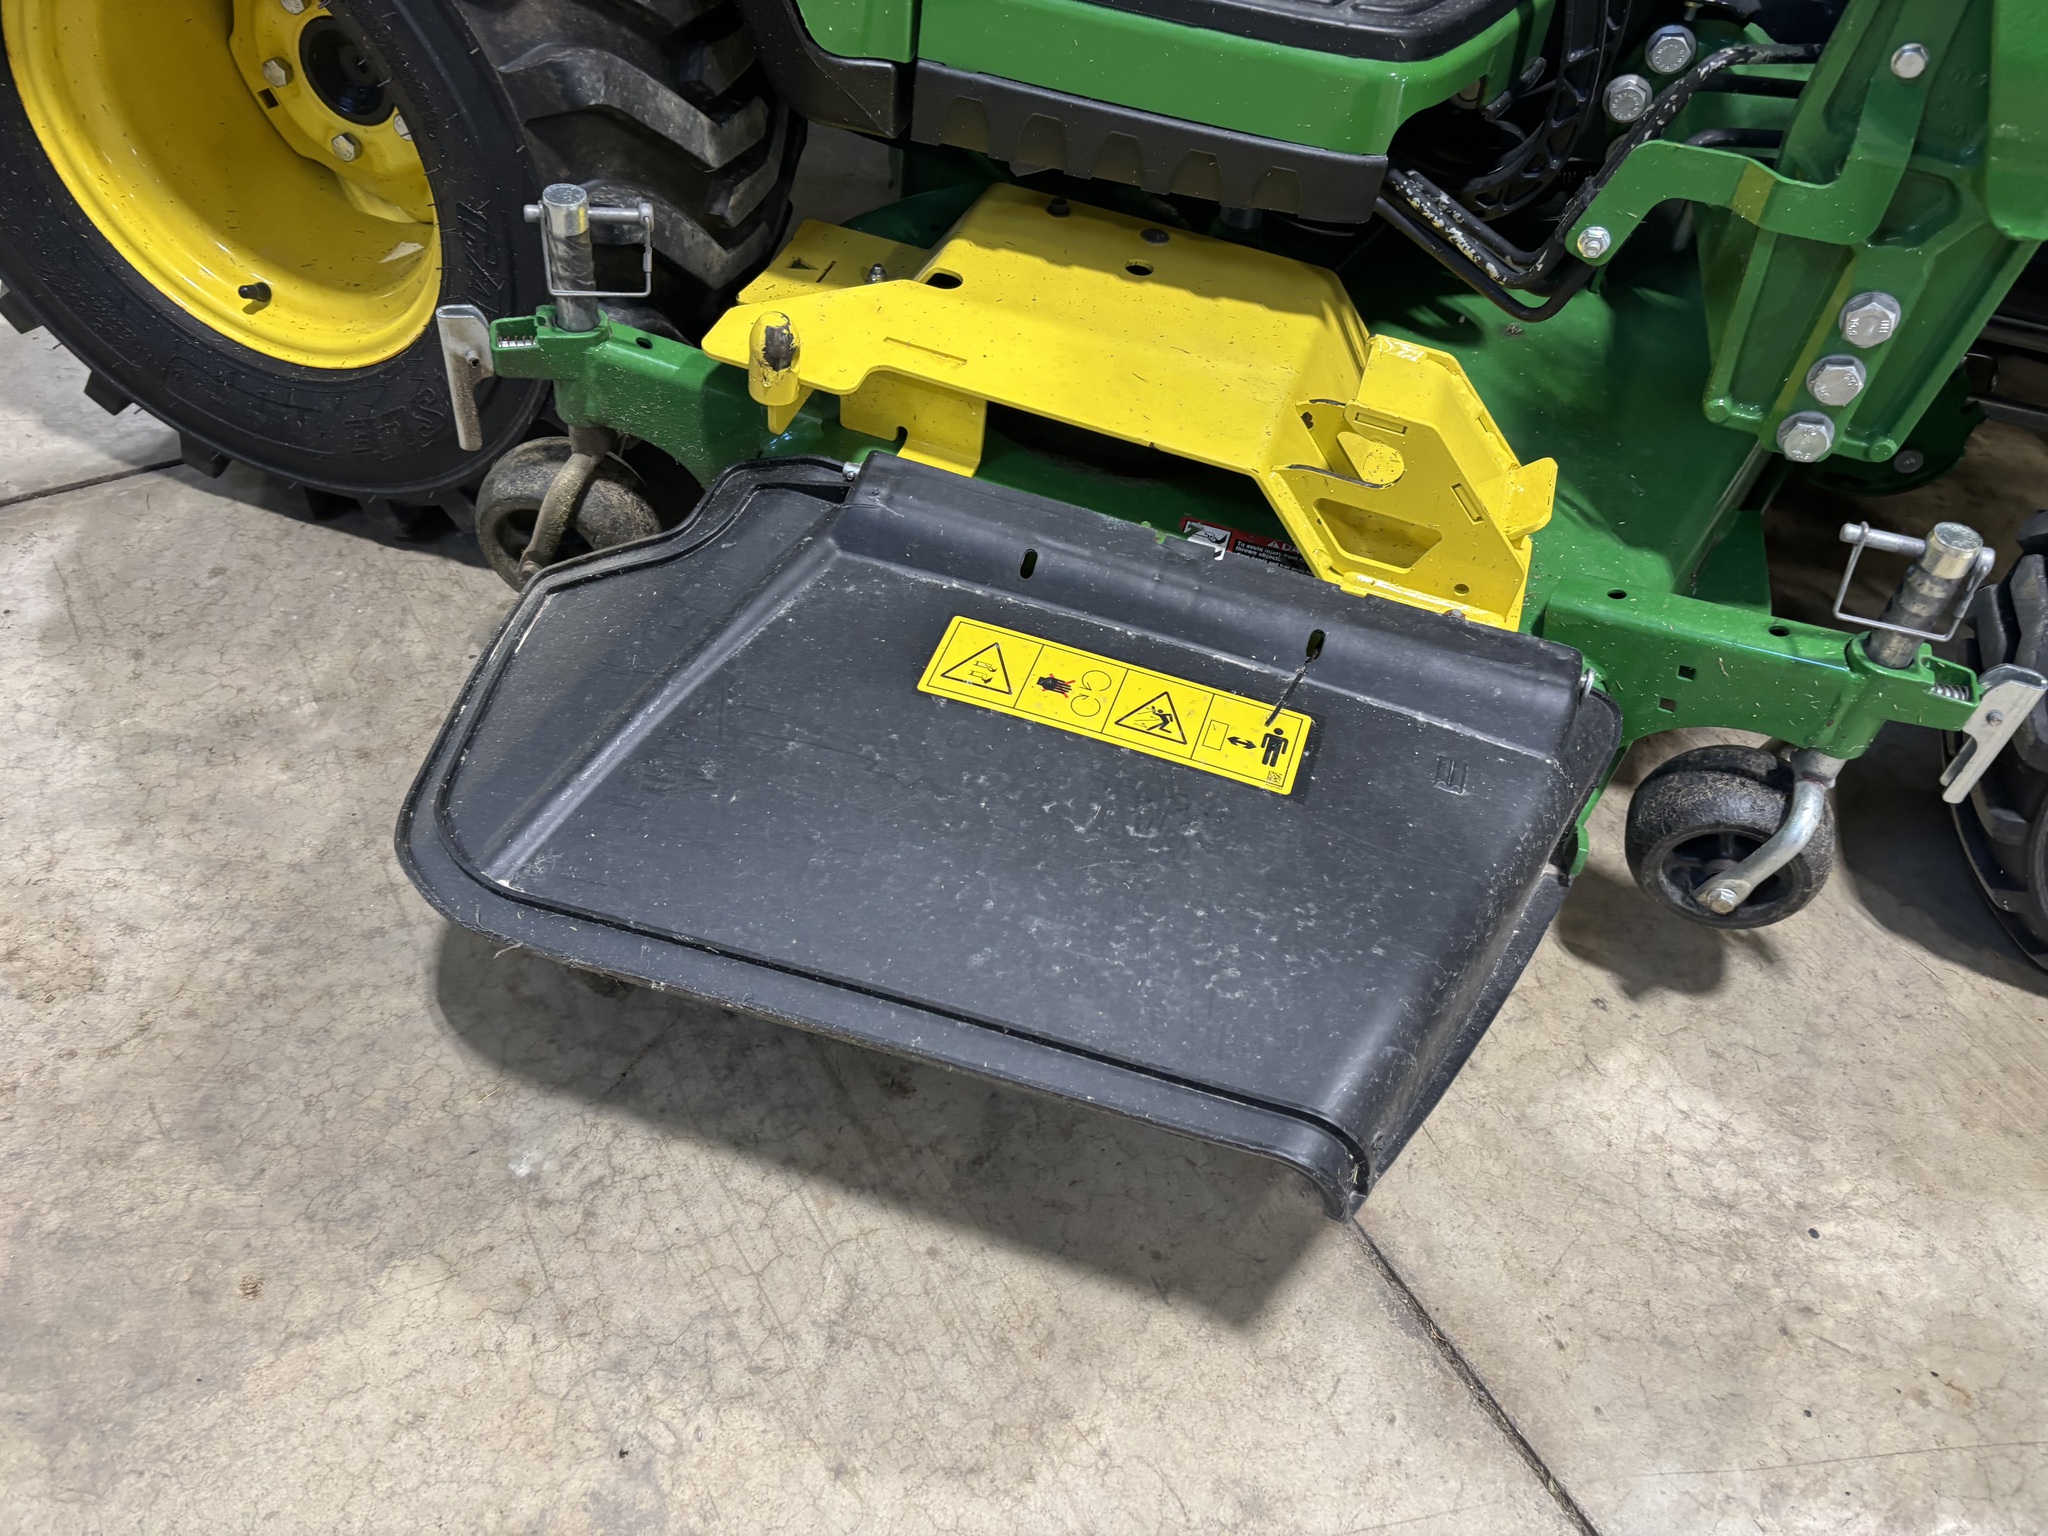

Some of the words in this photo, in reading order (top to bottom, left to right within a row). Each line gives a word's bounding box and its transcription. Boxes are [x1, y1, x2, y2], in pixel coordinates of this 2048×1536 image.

[1235, 546, 1257, 555] thrown
[1246, 544, 1264, 552] avoid
[1264, 548, 1282, 557] injury
